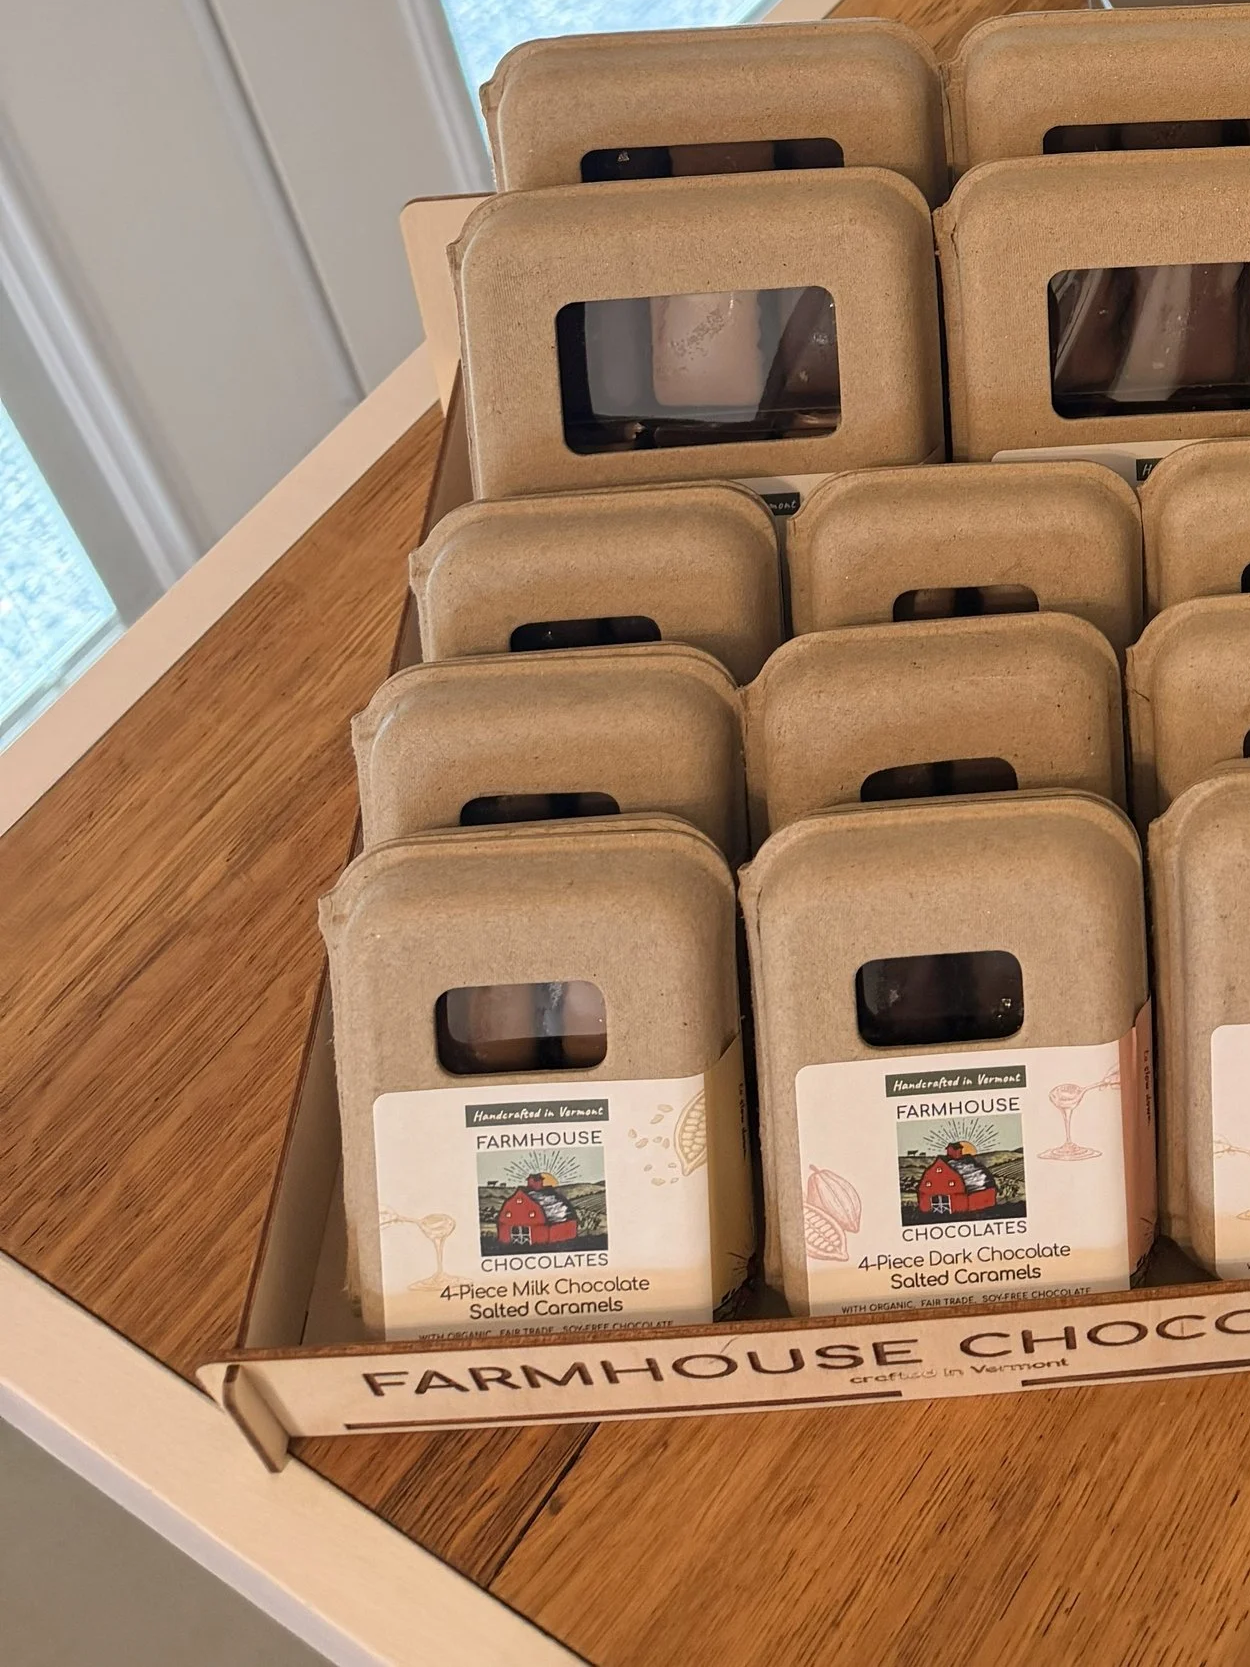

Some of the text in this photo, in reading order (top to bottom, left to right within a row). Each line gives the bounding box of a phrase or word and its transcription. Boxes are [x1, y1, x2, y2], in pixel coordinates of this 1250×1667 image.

[893, 1073, 1021, 1092] Handcrafted in Vermont
[473, 1106, 604, 1122] Handcrafted in Vermont
[897, 1097, 1020, 1119] FARMHOUSE
[476, 1130, 602, 1150] FARMHOUSE
[902, 1220, 1027, 1242] CHOCOLATES
[481, 1252, 609, 1273] CHOCOLATES
[858, 1243, 1071, 1272] 4-Piece Dark Chocolate
[891, 1264, 1041, 1290] Salted Caramels
[440, 1276, 650, 1301] 4-Piece Milk Chocolate
[469, 1297, 623, 1320] Salted Caramels
[841, 1304, 867, 1314] WITH
[921, 1298, 941, 1307] FAIR
[982, 1291, 1029, 1303] SOY-FREE
[361, 1337, 924, 1398] FARMHOUSE
[971, 1357, 1070, 1375] Vermont
